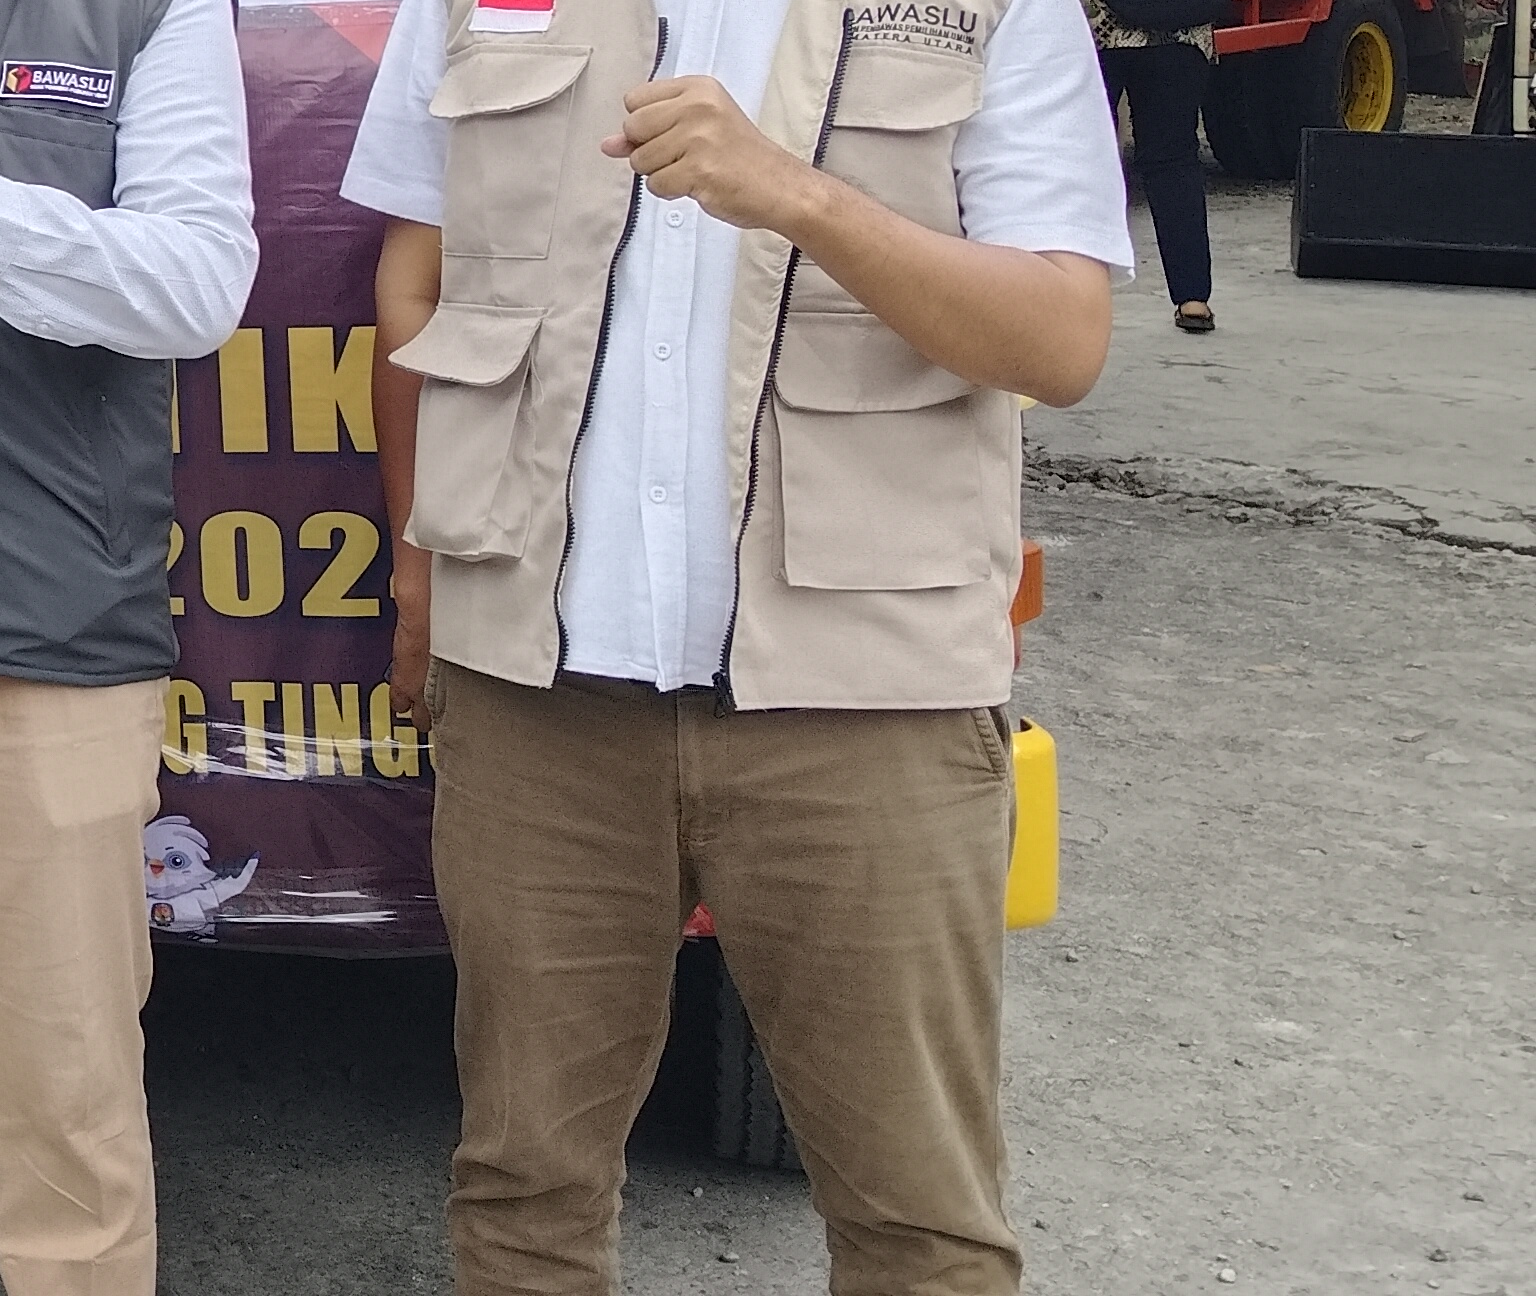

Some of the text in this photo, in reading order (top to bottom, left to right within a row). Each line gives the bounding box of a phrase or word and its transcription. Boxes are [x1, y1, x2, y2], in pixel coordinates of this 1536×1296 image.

[854, 3, 977, 33] AWASLU
[924, 37, 973, 55] UTARA
[32, 70, 110, 92] BAWASLU
[172, 326, 378, 455] IK
[167, 510, 395, 617] 02
[231, 681, 436, 777] TING
